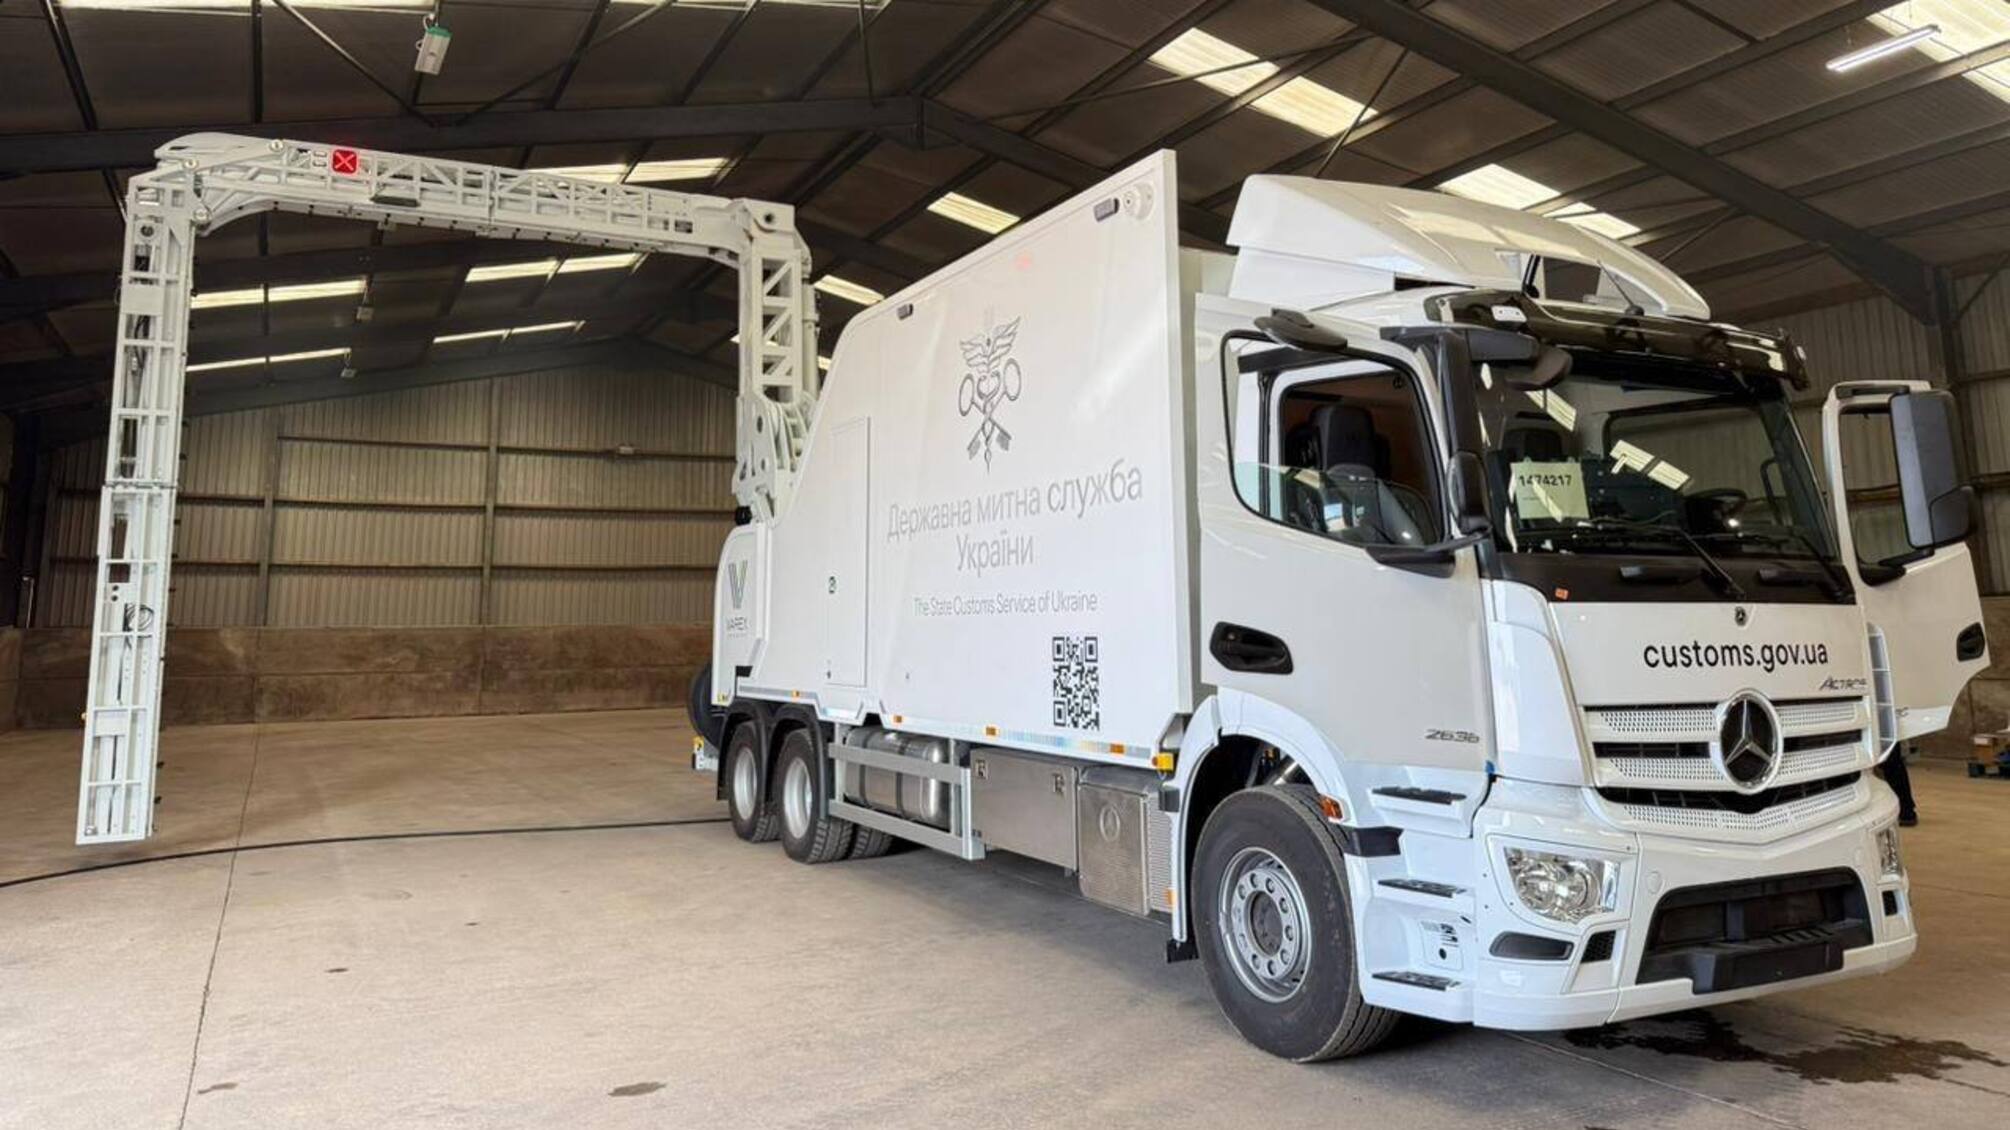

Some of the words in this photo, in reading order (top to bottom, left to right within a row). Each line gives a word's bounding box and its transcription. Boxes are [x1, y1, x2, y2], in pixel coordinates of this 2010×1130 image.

[1519, 474, 1572, 487] 1474217
[887, 499, 972, 542] Державна
[977, 486, 1041, 524] митна
[1047, 458, 1143, 519] служба
[956, 529, 1034, 577] України
[914, 597, 929, 616] The
[930, 596, 952, 616] State
[953, 594, 995, 616] Customs
[996, 592, 1037, 614] Service
[1038, 590, 1050, 612] of
[1051, 589, 1098, 612] Ukraine
[1643, 640, 1829, 673] customs.gov.ua
